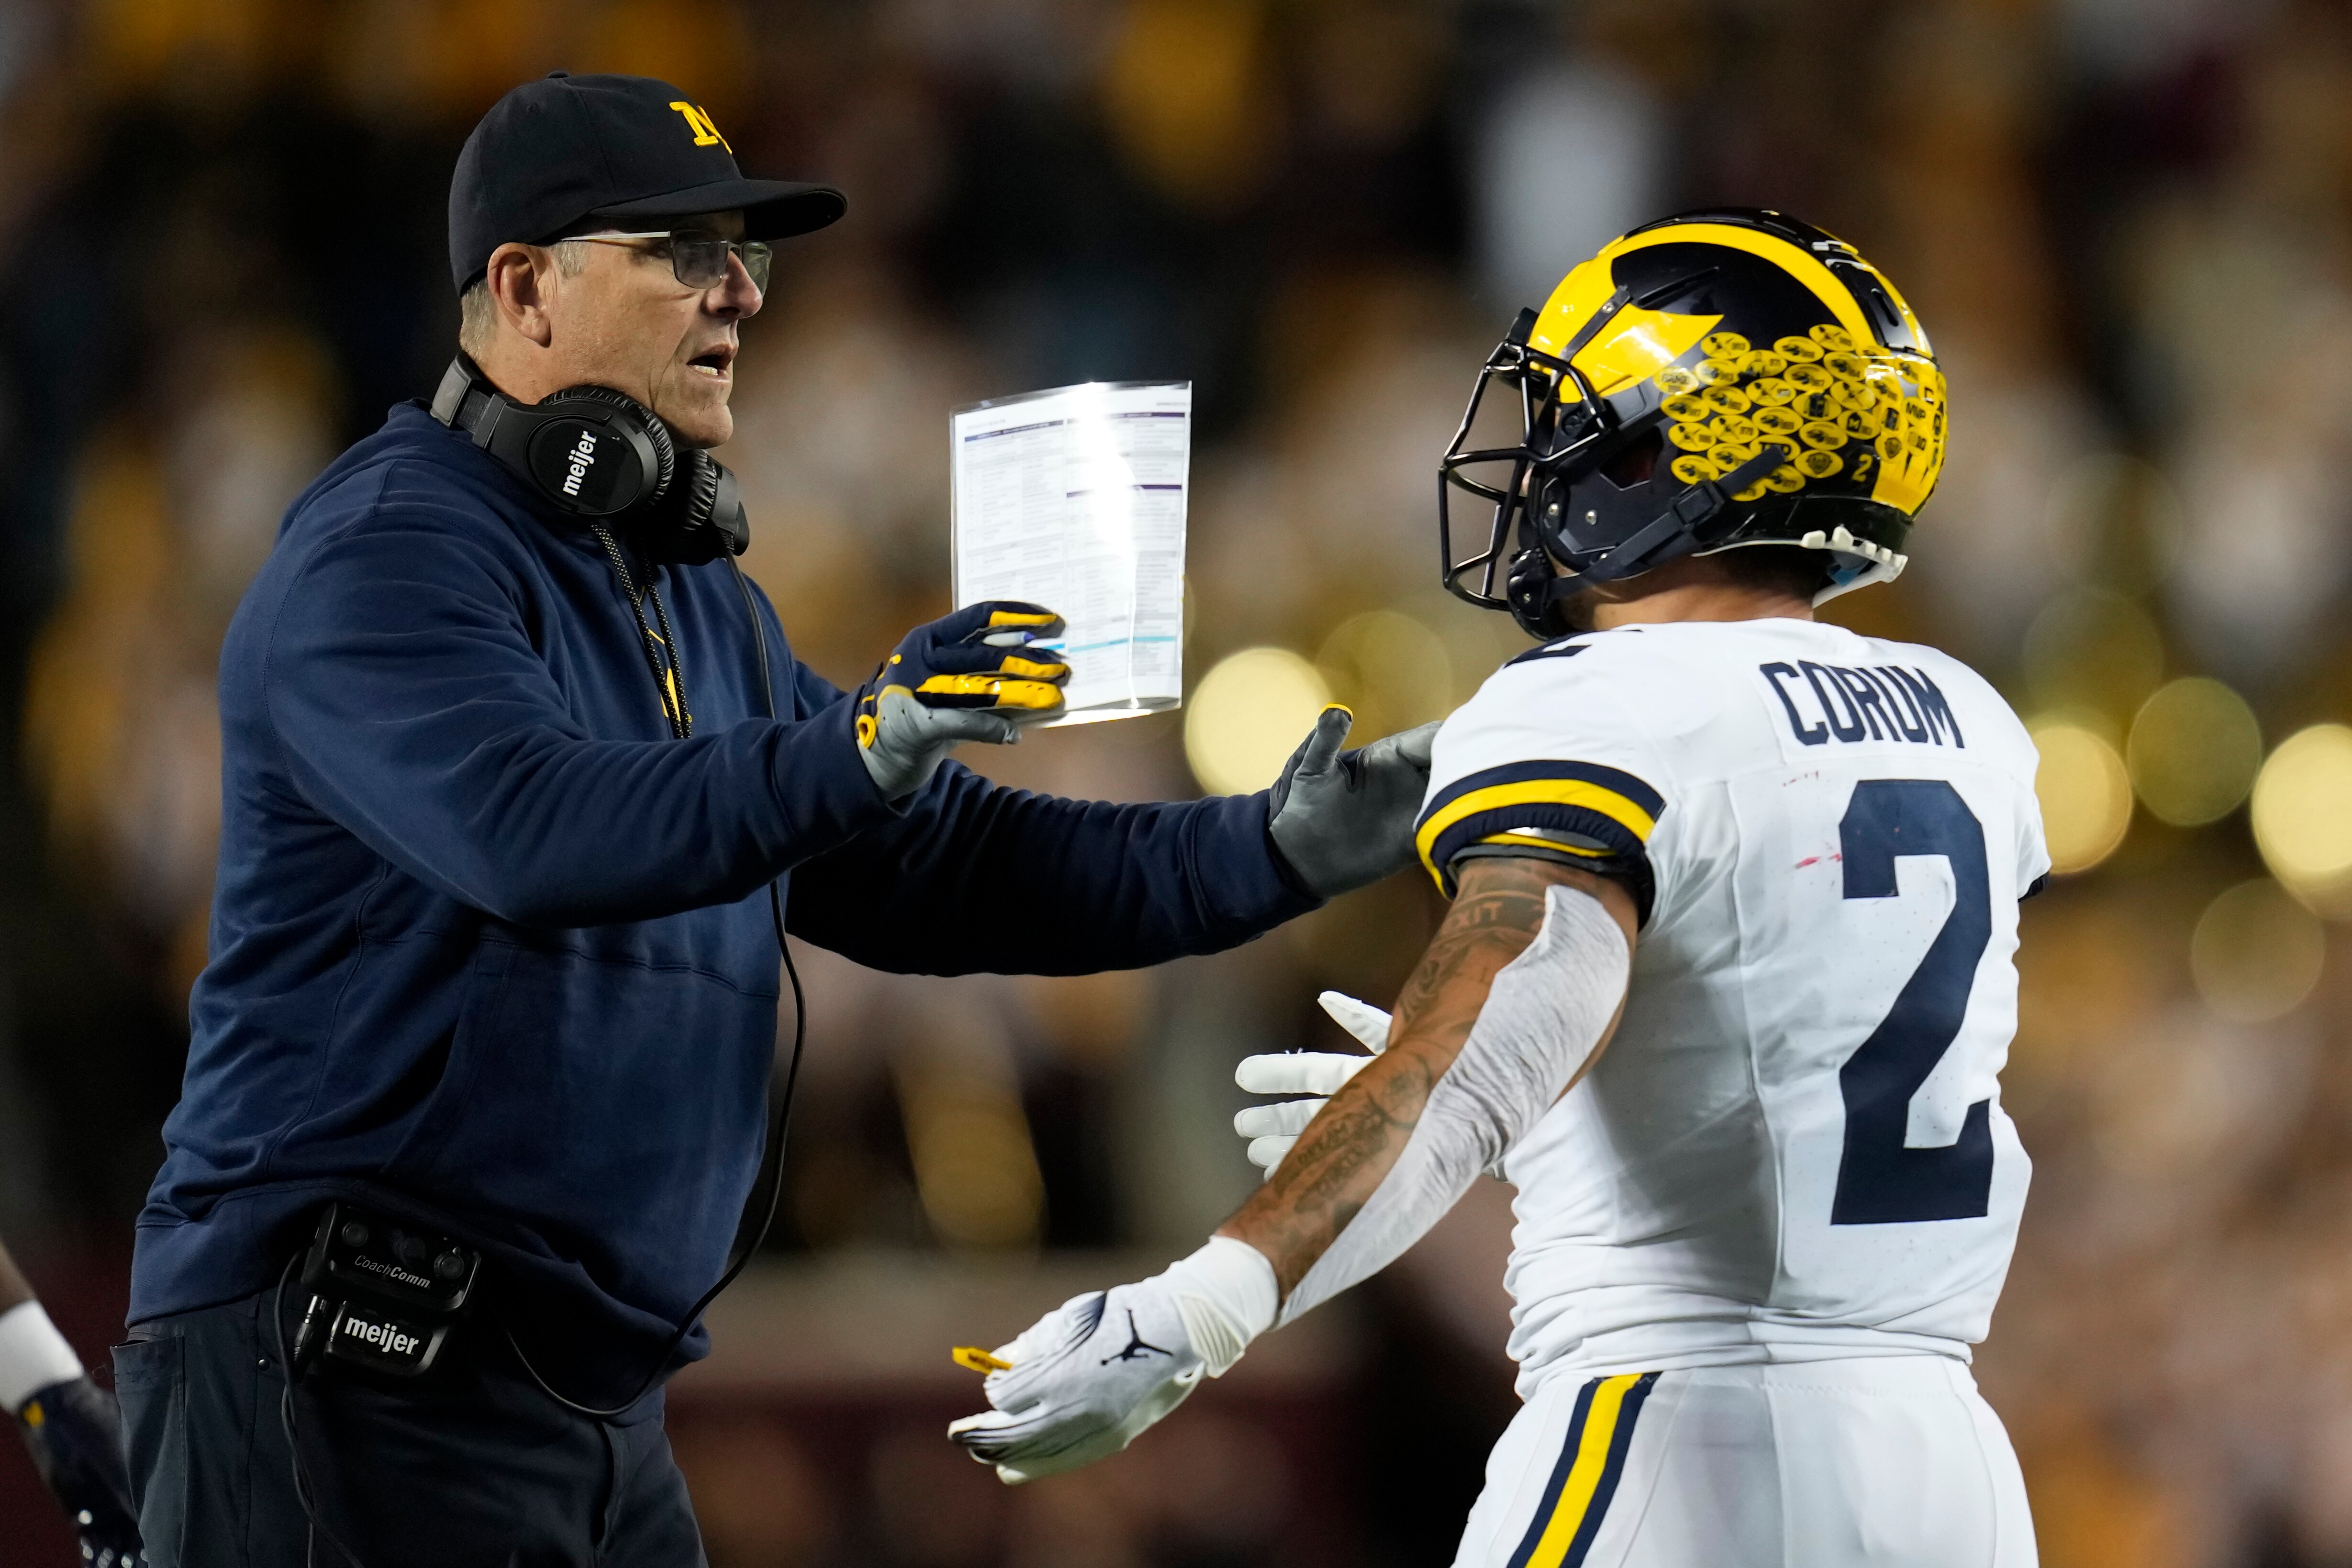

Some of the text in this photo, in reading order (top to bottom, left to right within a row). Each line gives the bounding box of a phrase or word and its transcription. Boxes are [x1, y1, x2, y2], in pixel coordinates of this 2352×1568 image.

[563, 431, 597, 496] meijer
[1852, 453, 1873, 482] 2
[1760, 660, 1965, 748] CORUM
[1830, 779, 1994, 1225] 2
[355, 1255, 430, 1289] CoachComm
[344, 1317, 419, 1355] meijer
